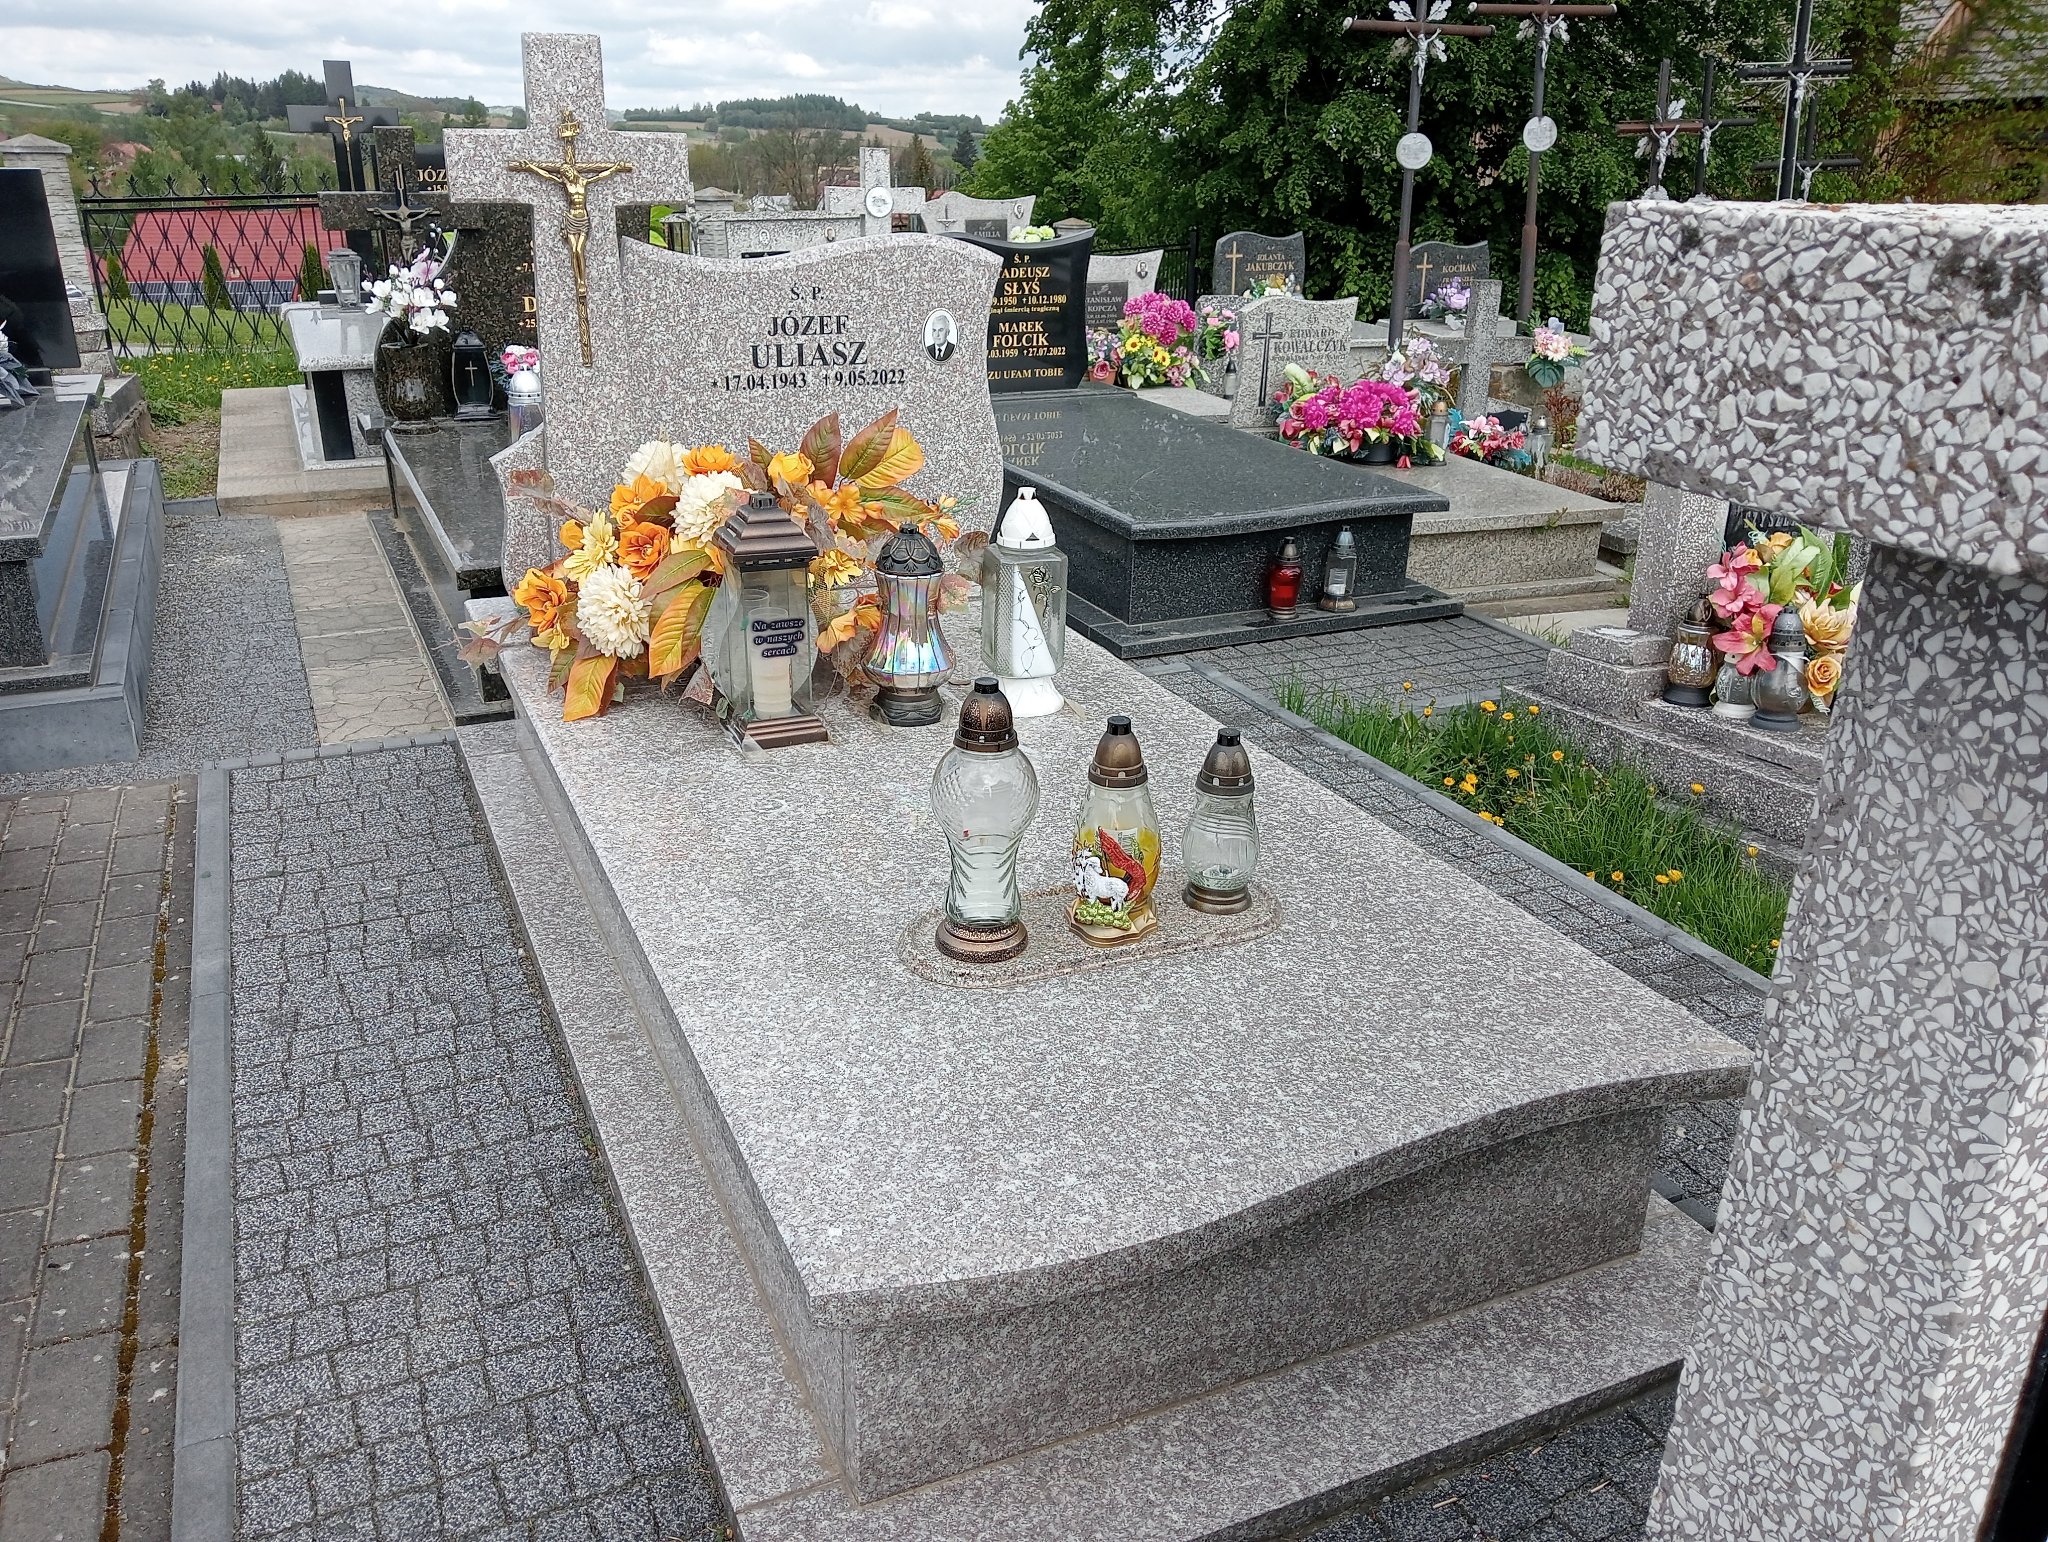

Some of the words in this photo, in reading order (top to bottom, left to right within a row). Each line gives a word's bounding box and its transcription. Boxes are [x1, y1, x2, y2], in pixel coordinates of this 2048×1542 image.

[417, 165, 447, 182] JÓZ
[1001, 266, 1050, 278] ADEUSZ
[1245, 261, 1295, 272] JAKUBCZYK
[812, 286, 825, 300] P.
[1004, 278, 1041, 295] SŁYŚ
[992, 296, 1018, 306] 9.1950
[1028, 294, 1067, 305] 10.12.1980
[1085, 296, 1122, 304] TANISŁAW
[767, 310, 849, 337] JÓZEF
[999, 321, 1044, 333] MAREK
[993, 333, 1050, 348] FOLCIK
[1274, 339, 1346, 354] KOWALCZYK
[751, 341, 868, 369] ULIASZ
[1028, 346, 1067, 357] 27.07.2022
[724, 372, 807, 391] 17.04.1943
[834, 368, 906, 387] 9.05.2022
[988, 370, 1001, 380] ZU
[1003, 369, 1032, 379] UFAM
[1034, 367, 1064, 377] TOBIE
[753, 621, 767, 632] Na
[770, 619, 804, 629] zawsze
[754, 636, 764, 644] w
[767, 631, 803, 644] naszych
[762, 645, 797, 657] sercach
